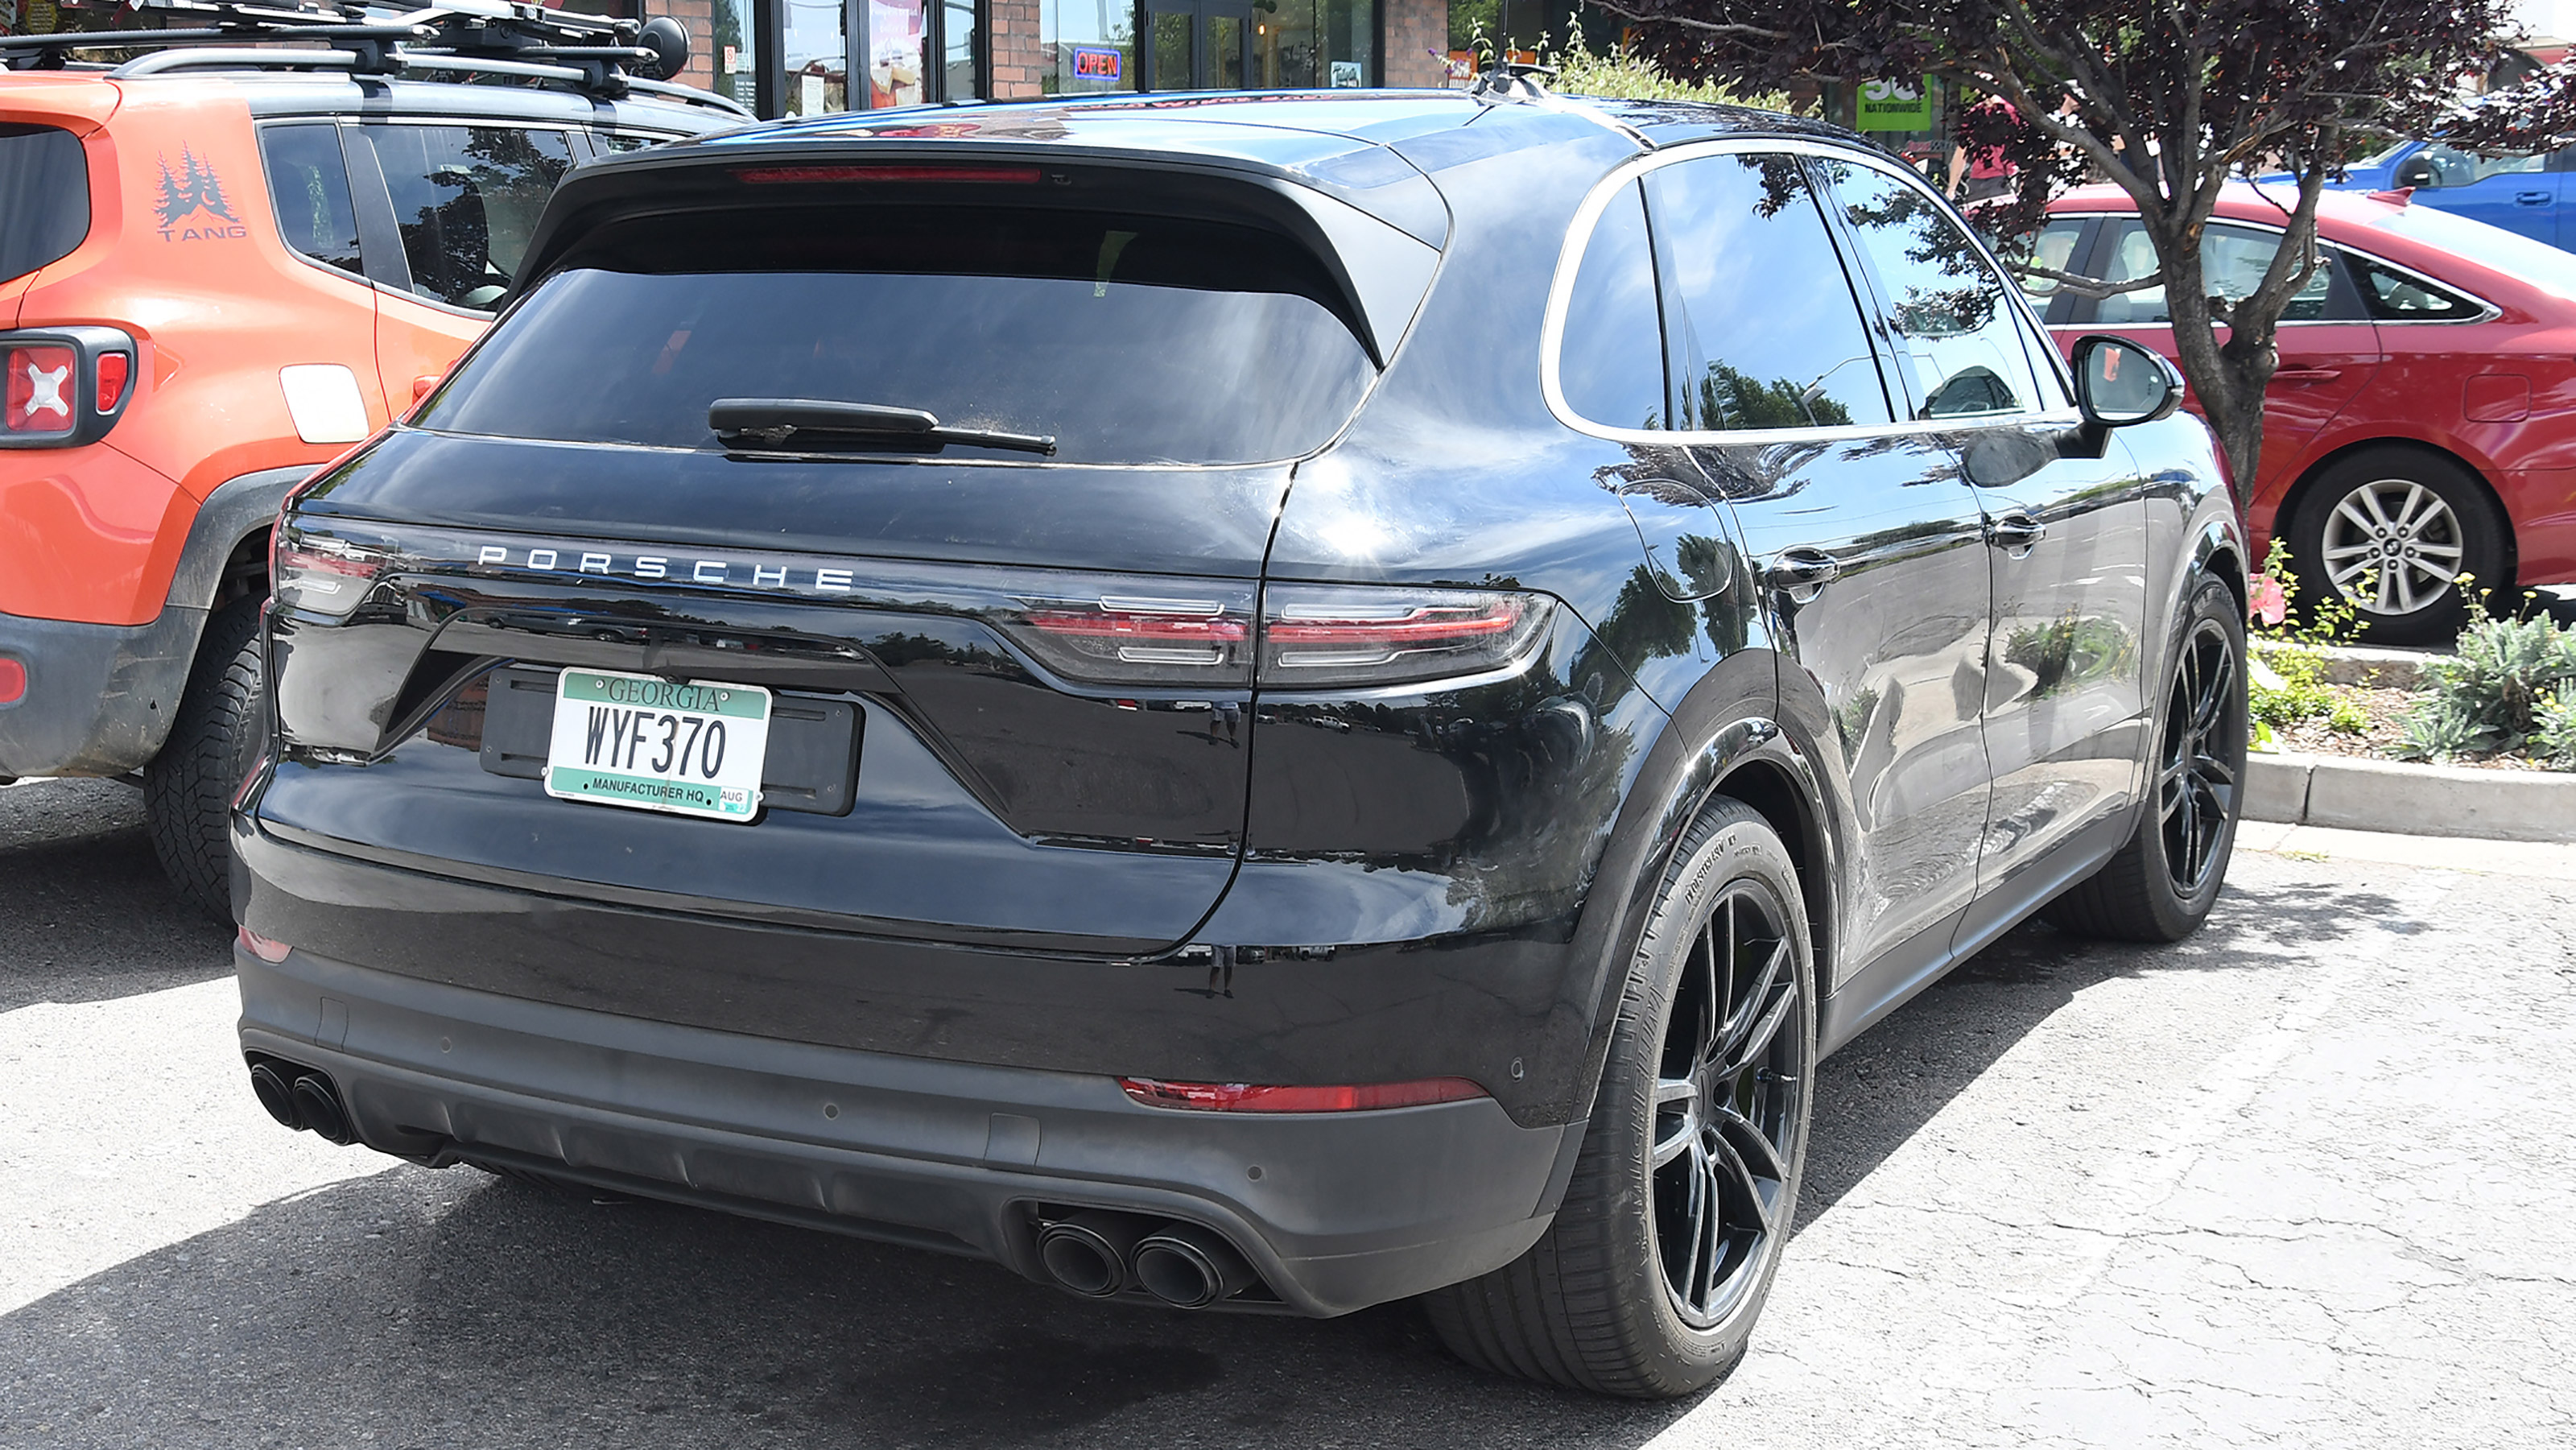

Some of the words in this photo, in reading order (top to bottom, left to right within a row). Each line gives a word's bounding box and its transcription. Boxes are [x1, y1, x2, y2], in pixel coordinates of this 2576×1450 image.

[1078, 52, 1117, 75] OPEN
[1864, 103, 1922, 113] NATIONWIDE
[157, 226, 246, 242] TANG
[478, 546, 854, 591] PORSCHE
[609, 678, 720, 712] GEORGIA
[585, 706, 726, 779] WYF370
[592, 778, 683, 799] MANUFACTURER
[687, 790, 704, 803] HQ
[720, 791, 743, 803] AUG
[1629, 985, 1666, 1215] MICHELIN
